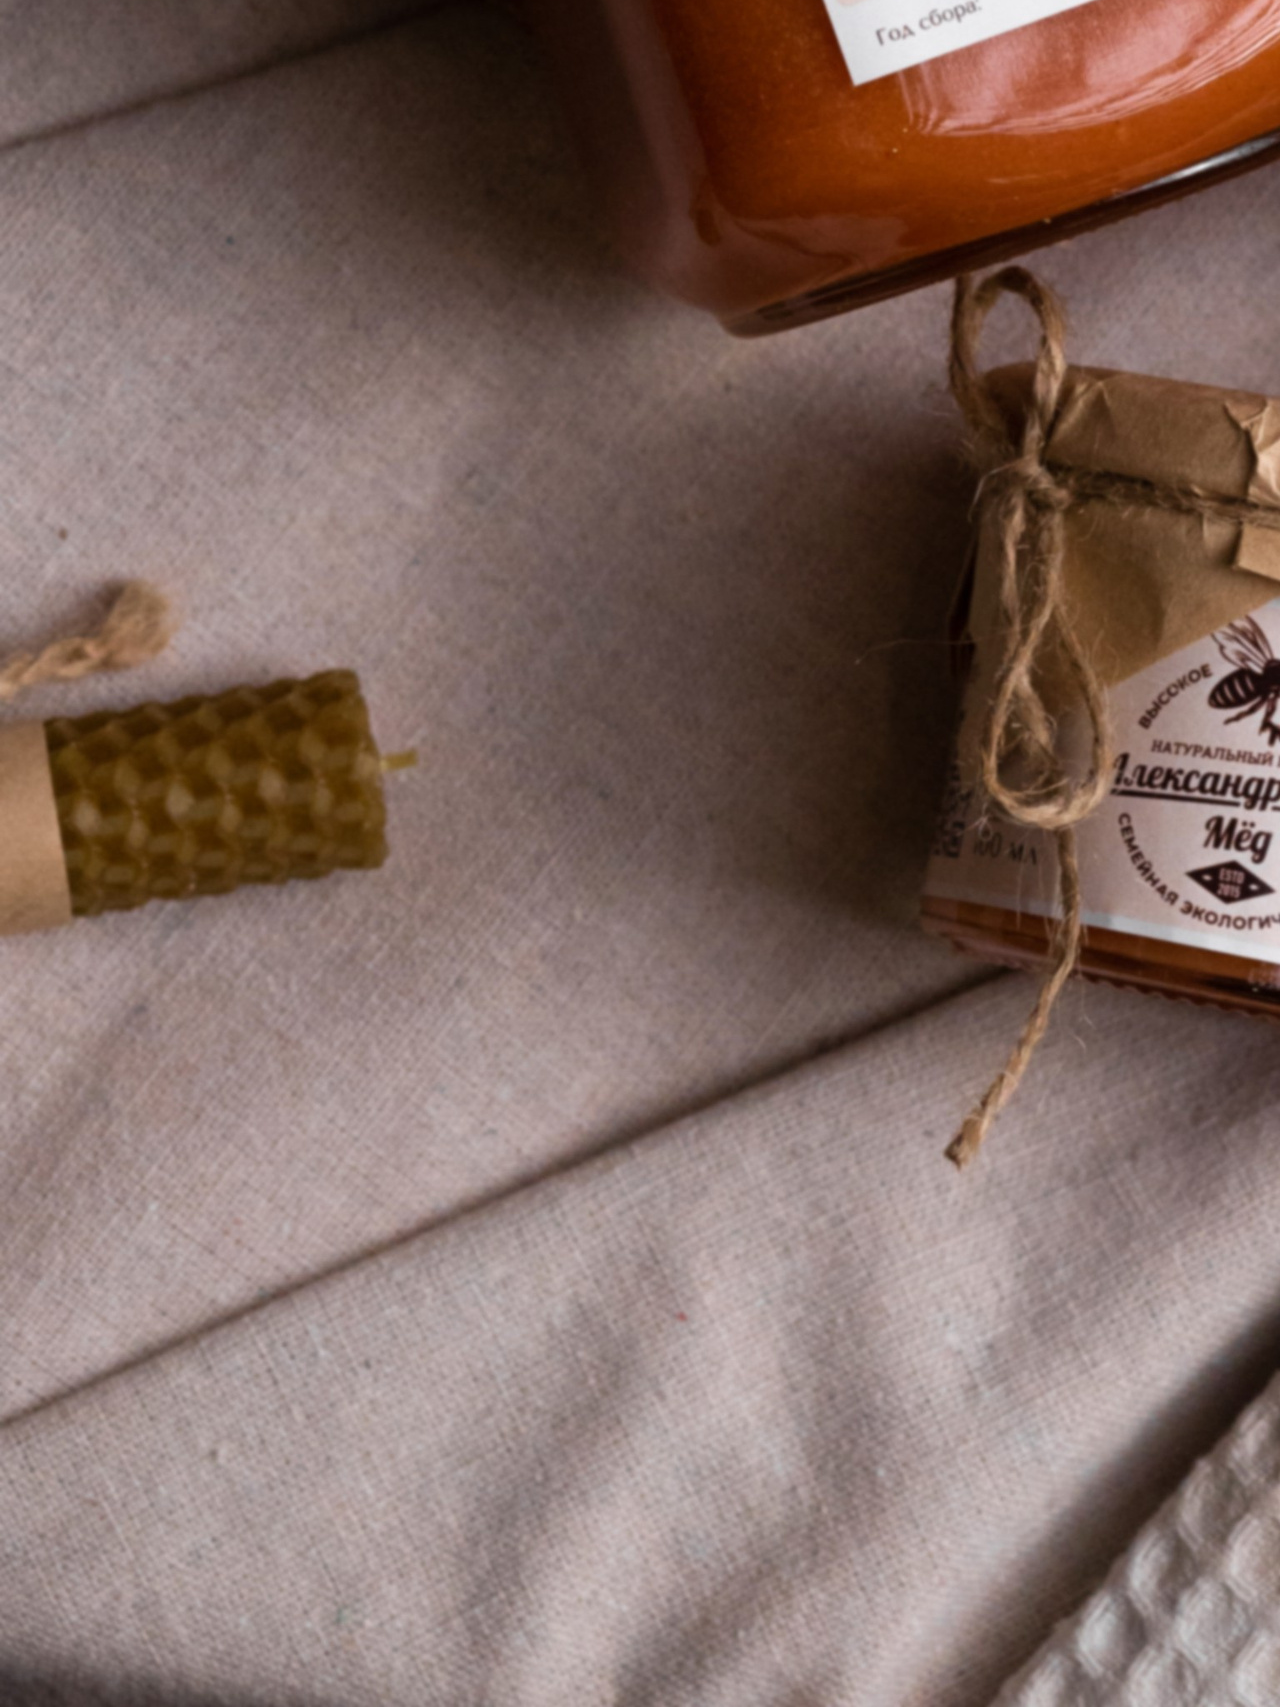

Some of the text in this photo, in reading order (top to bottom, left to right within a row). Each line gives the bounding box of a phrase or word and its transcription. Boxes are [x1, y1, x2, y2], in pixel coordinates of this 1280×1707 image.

[875, 24, 916, 46] Год
[1138, 663, 1213, 729] ВЫСОКОЕ
[1151, 739, 1273, 766] НАТУРАЛЬНЫЙ
[1118, 812, 1179, 906] СЕМЕЙНАЯ
[1203, 815, 1273, 864] Мёд
